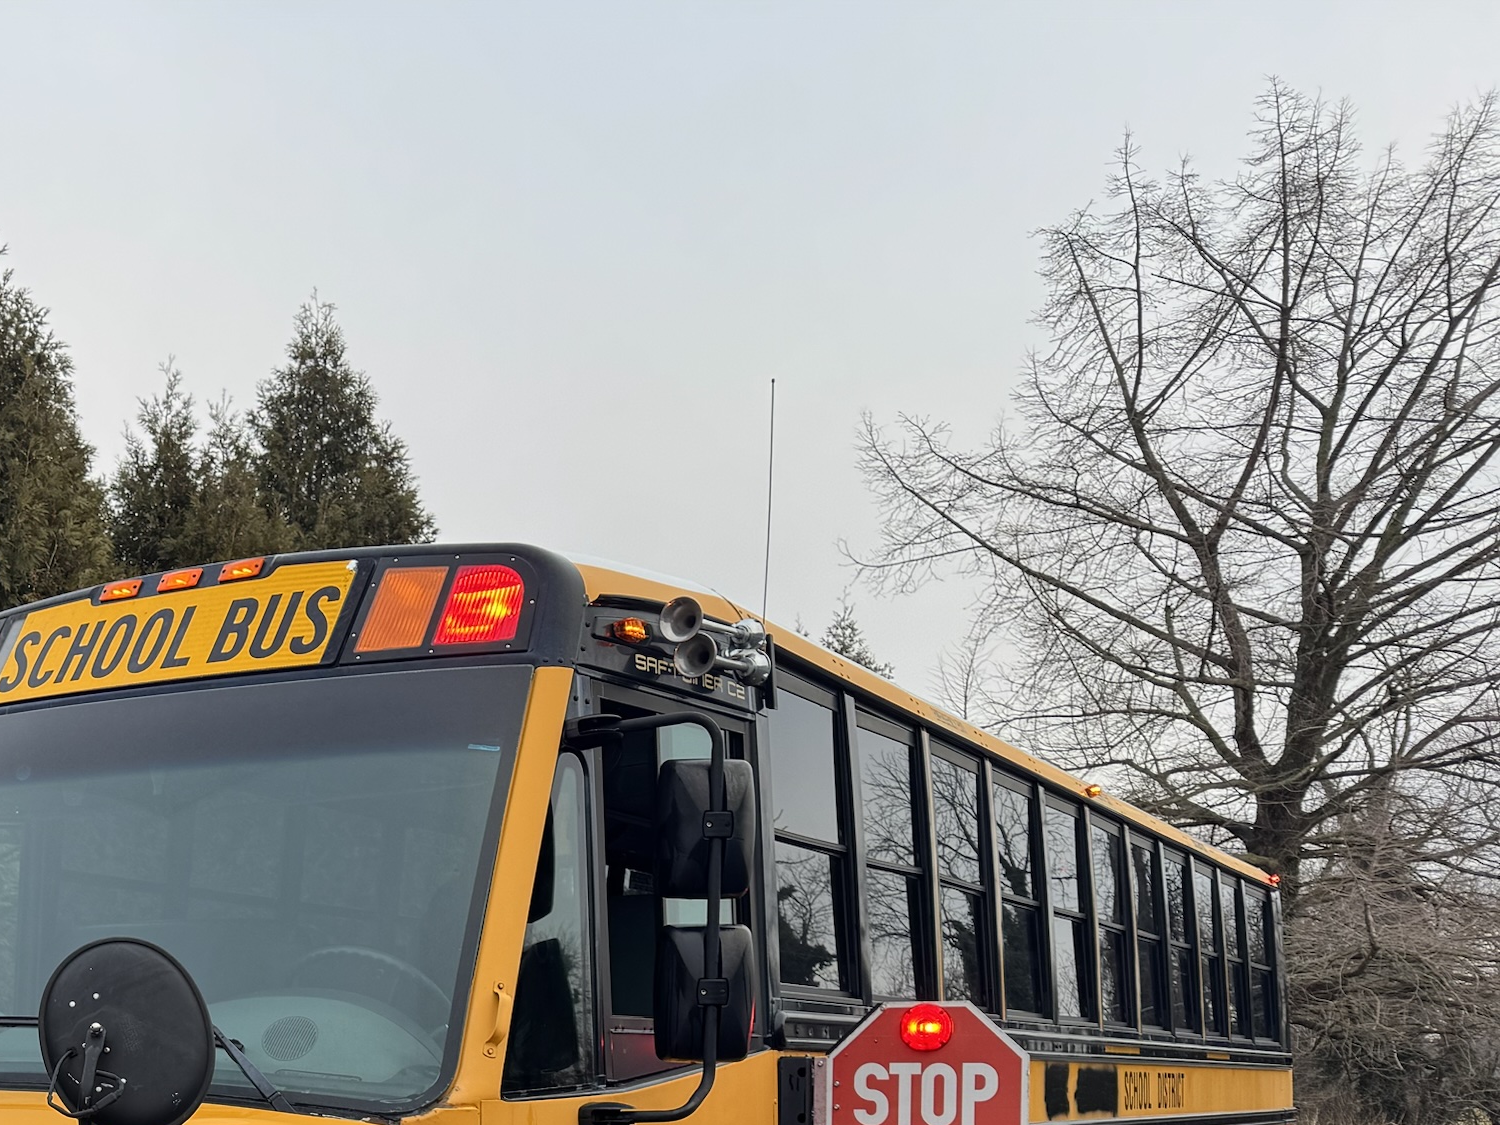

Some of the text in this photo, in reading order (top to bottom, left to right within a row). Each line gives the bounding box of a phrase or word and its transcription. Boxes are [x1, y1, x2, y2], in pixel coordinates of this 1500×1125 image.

[206, 585, 341, 663] BUS
[635, 653, 746, 700] SAF-TER C2
[1124, 1071, 1185, 1110] SCHOOL DISTRICT
